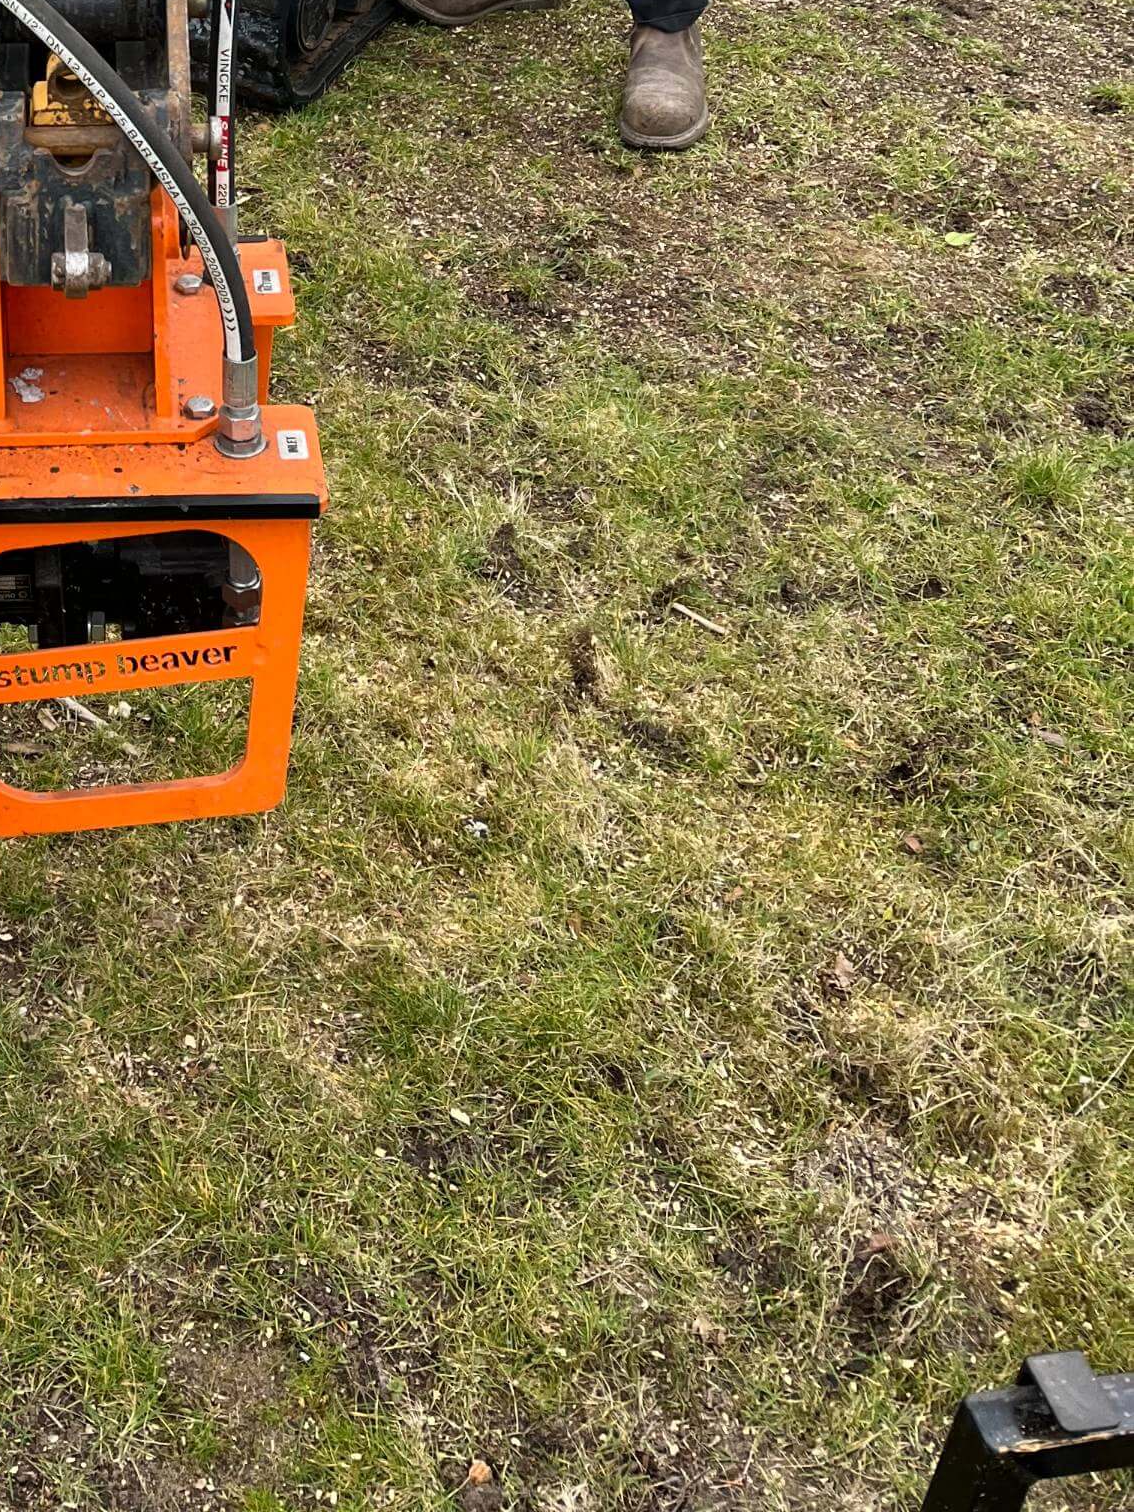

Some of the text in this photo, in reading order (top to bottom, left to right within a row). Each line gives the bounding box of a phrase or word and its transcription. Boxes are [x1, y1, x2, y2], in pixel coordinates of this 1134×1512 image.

[218, 48, 230, 105] VINCKE
[46, 34, 64, 55] DN
[66, 57, 81, 72] 12
[106, 103, 128, 127] 275
[127, 129, 152, 158] BAR
[150, 160, 180, 199] MSHA
[217, 183, 228, 208] 220
[286, 436, 300, 454] INLET
[117, 644, 238, 675] beaver
